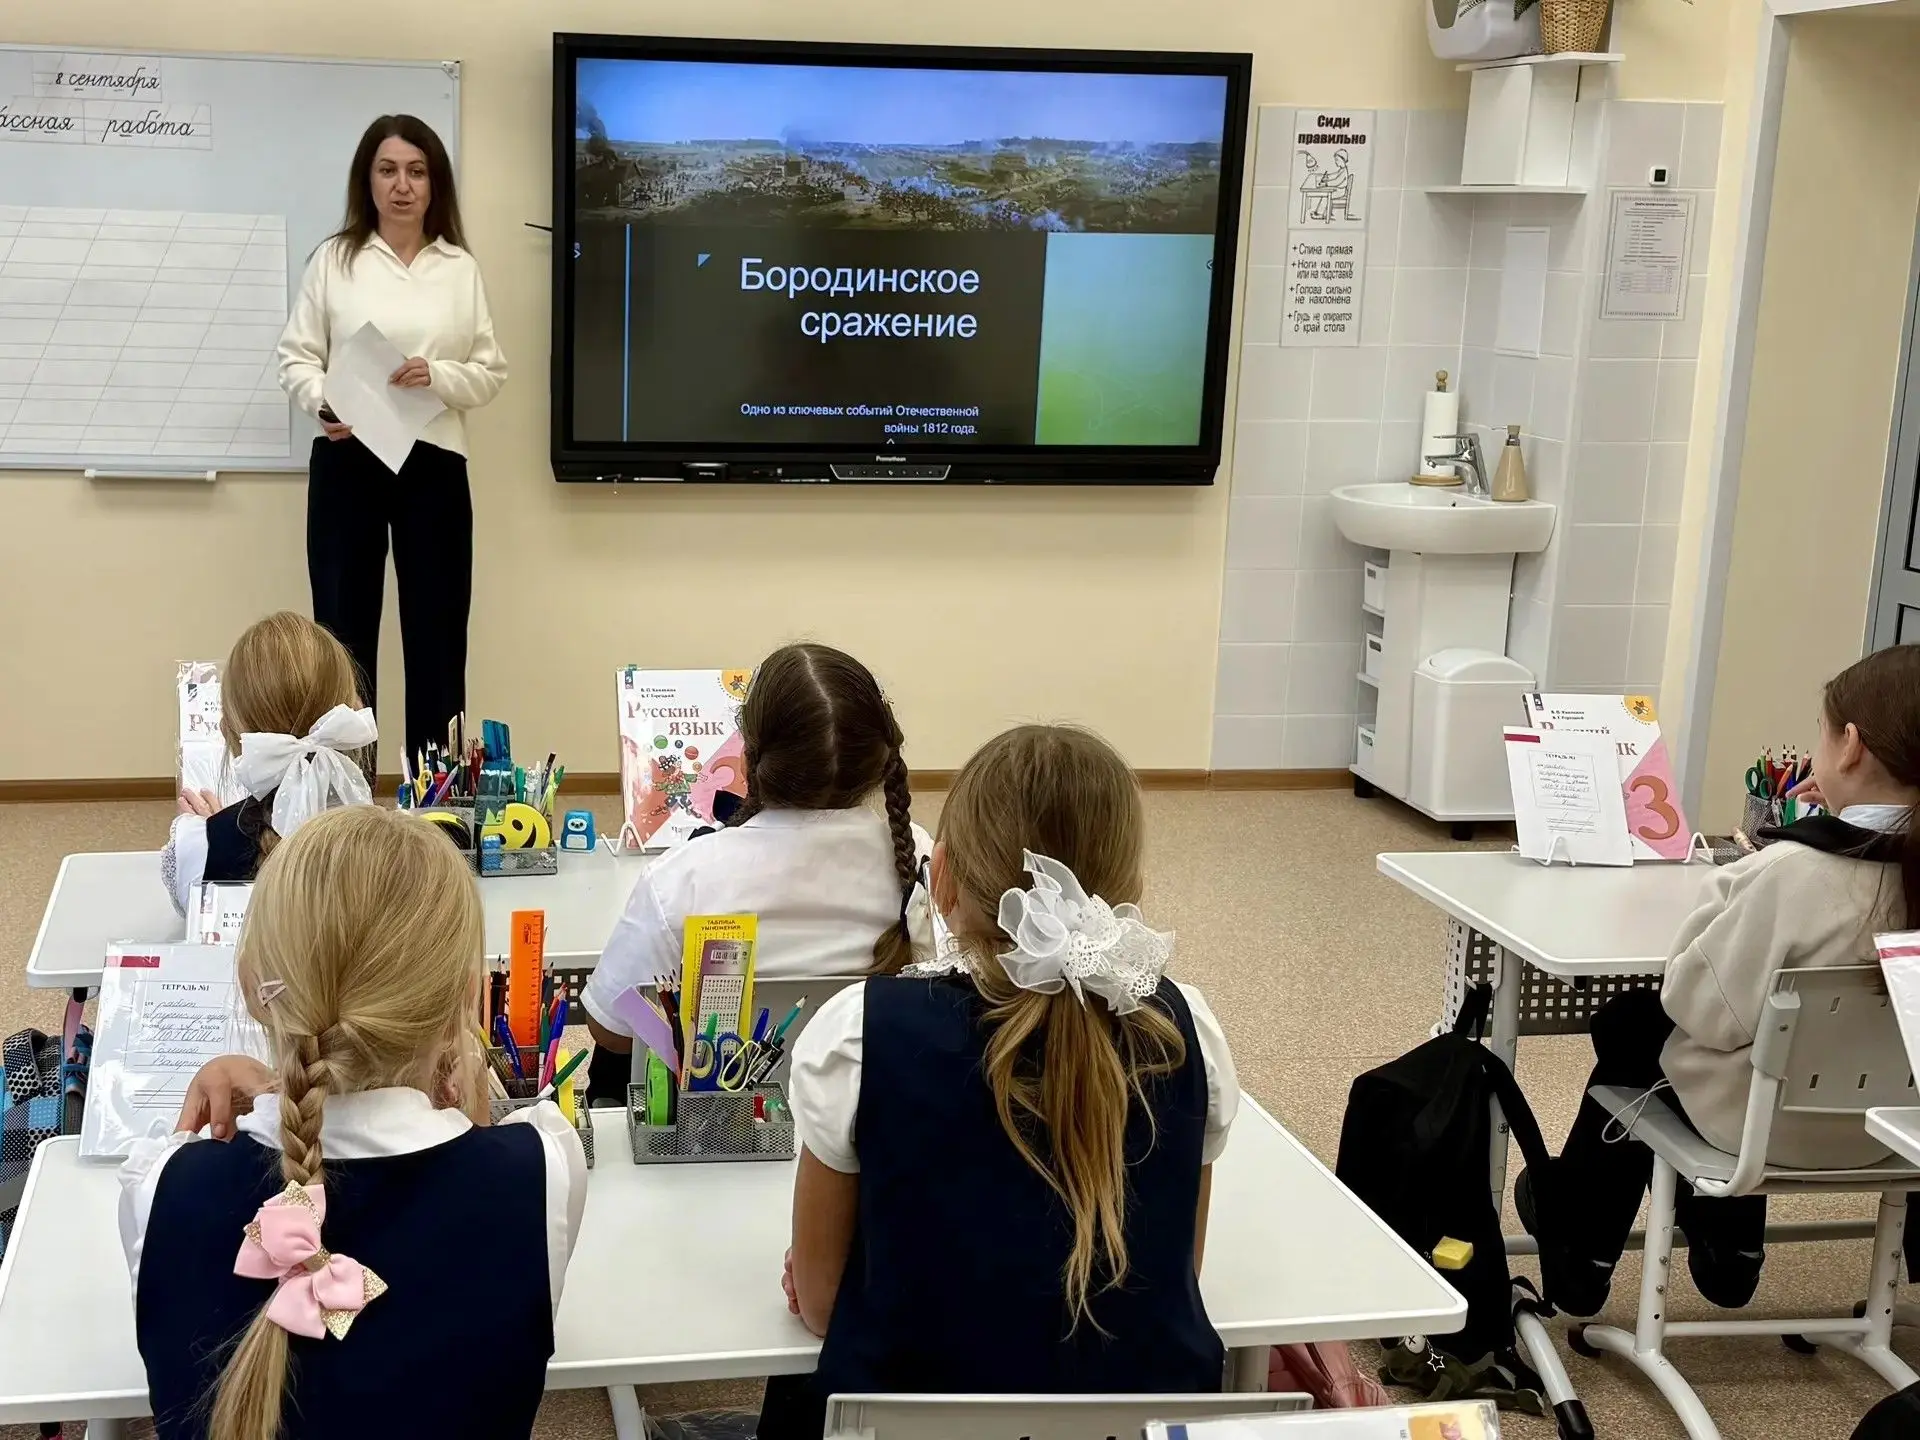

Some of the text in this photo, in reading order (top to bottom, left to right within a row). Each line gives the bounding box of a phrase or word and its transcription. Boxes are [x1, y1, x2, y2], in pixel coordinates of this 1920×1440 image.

[55, 72, 63, 85] 8
[1317, 115, 1350, 129] Сиди
[1298, 133, 1366, 145] правильно
[1298, 243, 1353, 257] Спина прямая
[1297, 260, 1354, 271] Ноги на полу
[741, 257, 980, 299] Бородинское
[1296, 270, 1354, 280] или на подставке
[1295, 283, 1352, 295] Голова сильно
[1294, 295, 1351, 304] не наклонена
[800, 311, 978, 344] сражение
[1302, 322, 1321, 334] край
[1323, 323, 1346, 333] стола
[740, 403, 979, 417] Одно из ключевых событий Отечественной
[884, 422, 978, 435] войны 1812 года.
[1630, 775, 1680, 840] 3
[161, 983, 197, 991] ТЕТРАДЬ
